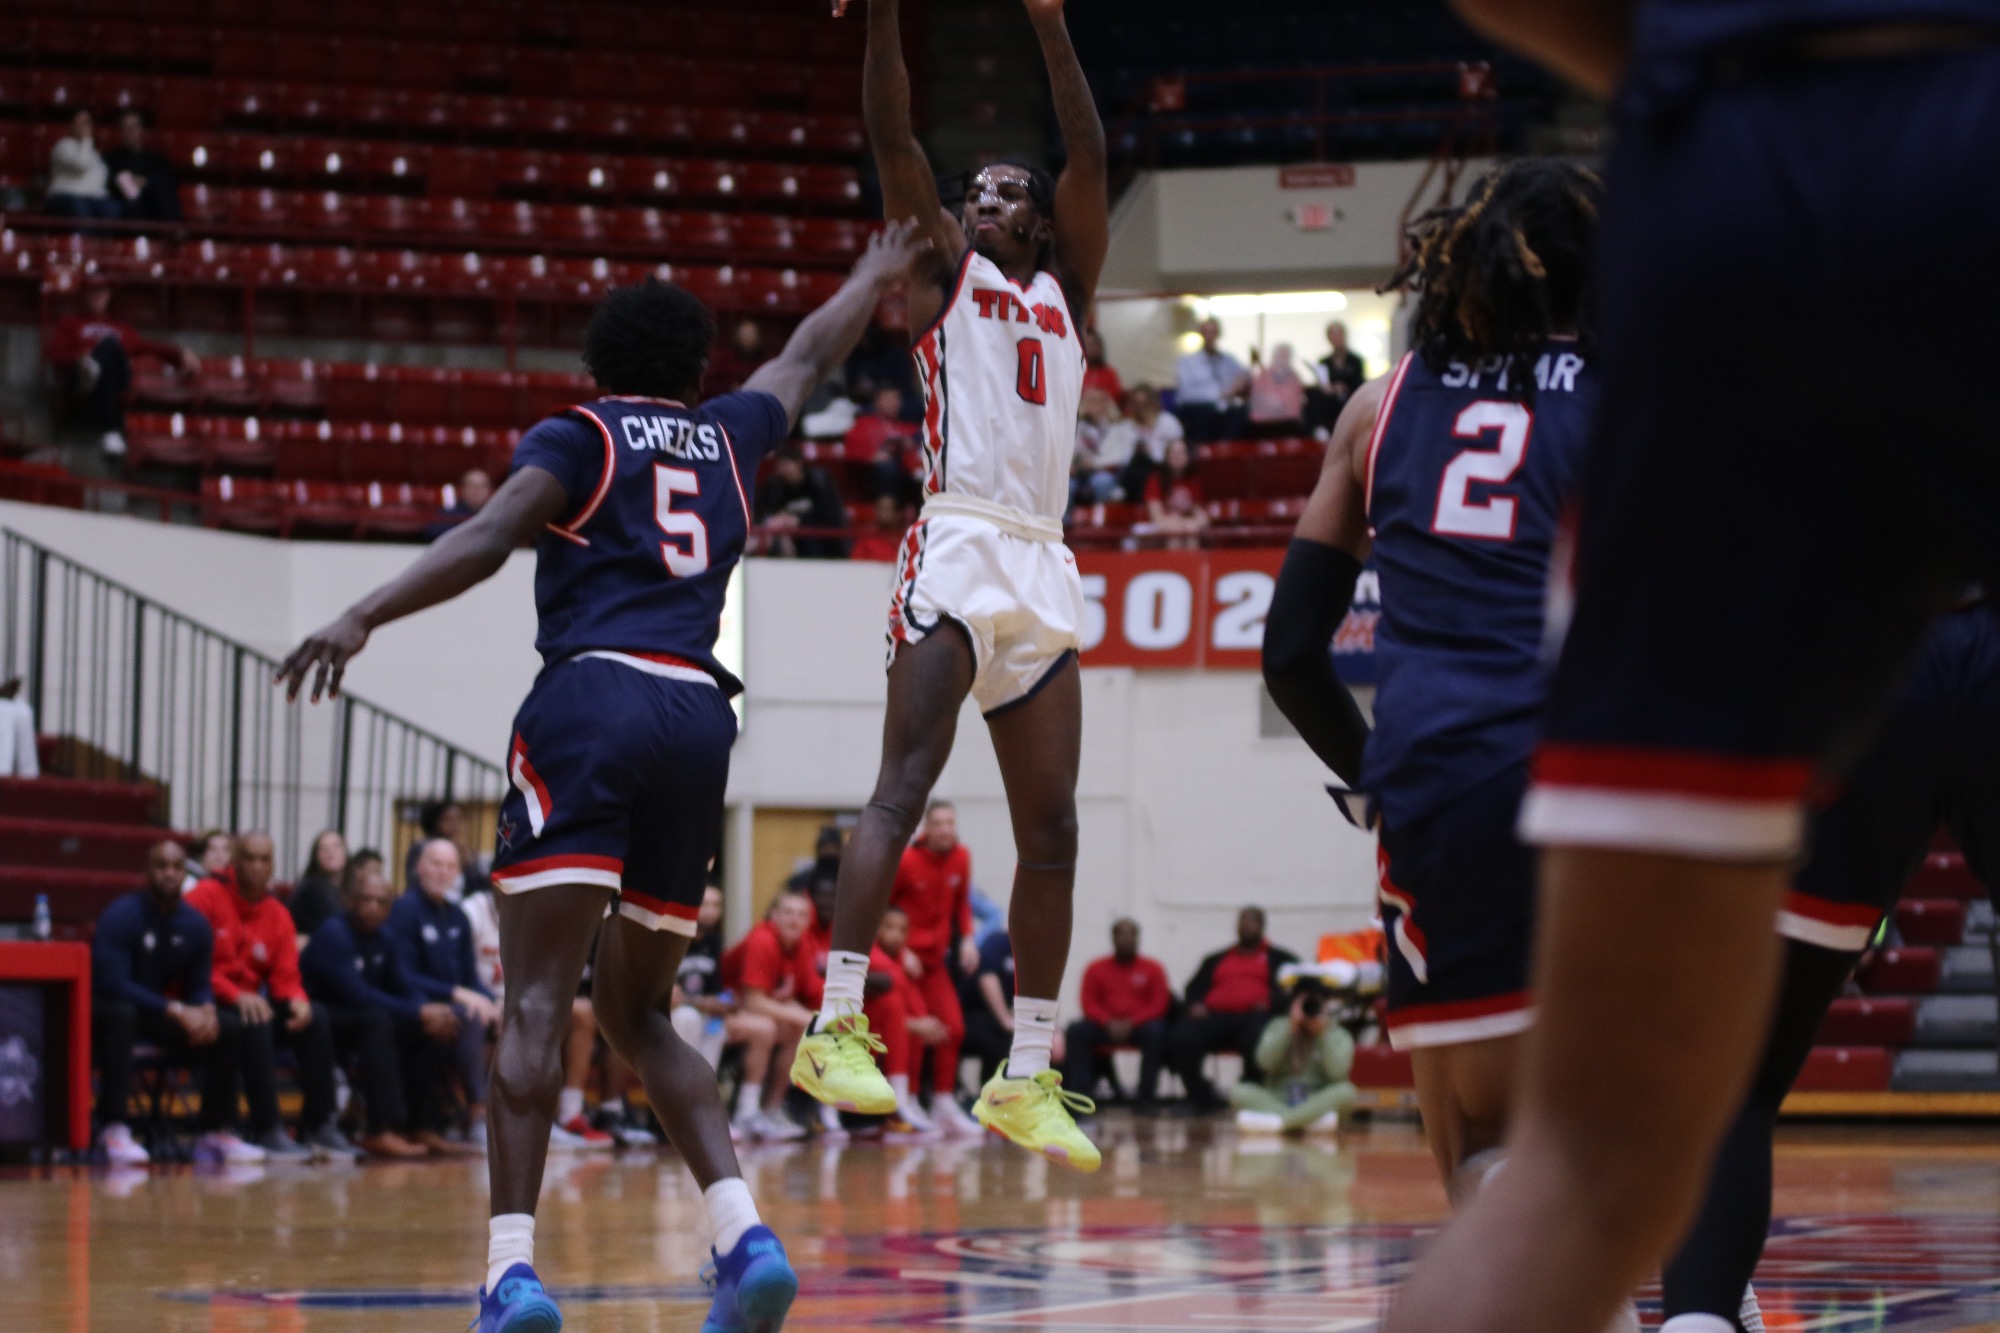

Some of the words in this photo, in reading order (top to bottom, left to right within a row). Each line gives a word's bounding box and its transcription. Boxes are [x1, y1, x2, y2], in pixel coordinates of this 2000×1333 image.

[1016, 337, 1047, 406] 0
[620, 415, 721, 462] CHEEKS
[1430, 399, 1535, 541] 2
[653, 460, 711, 578] 5
